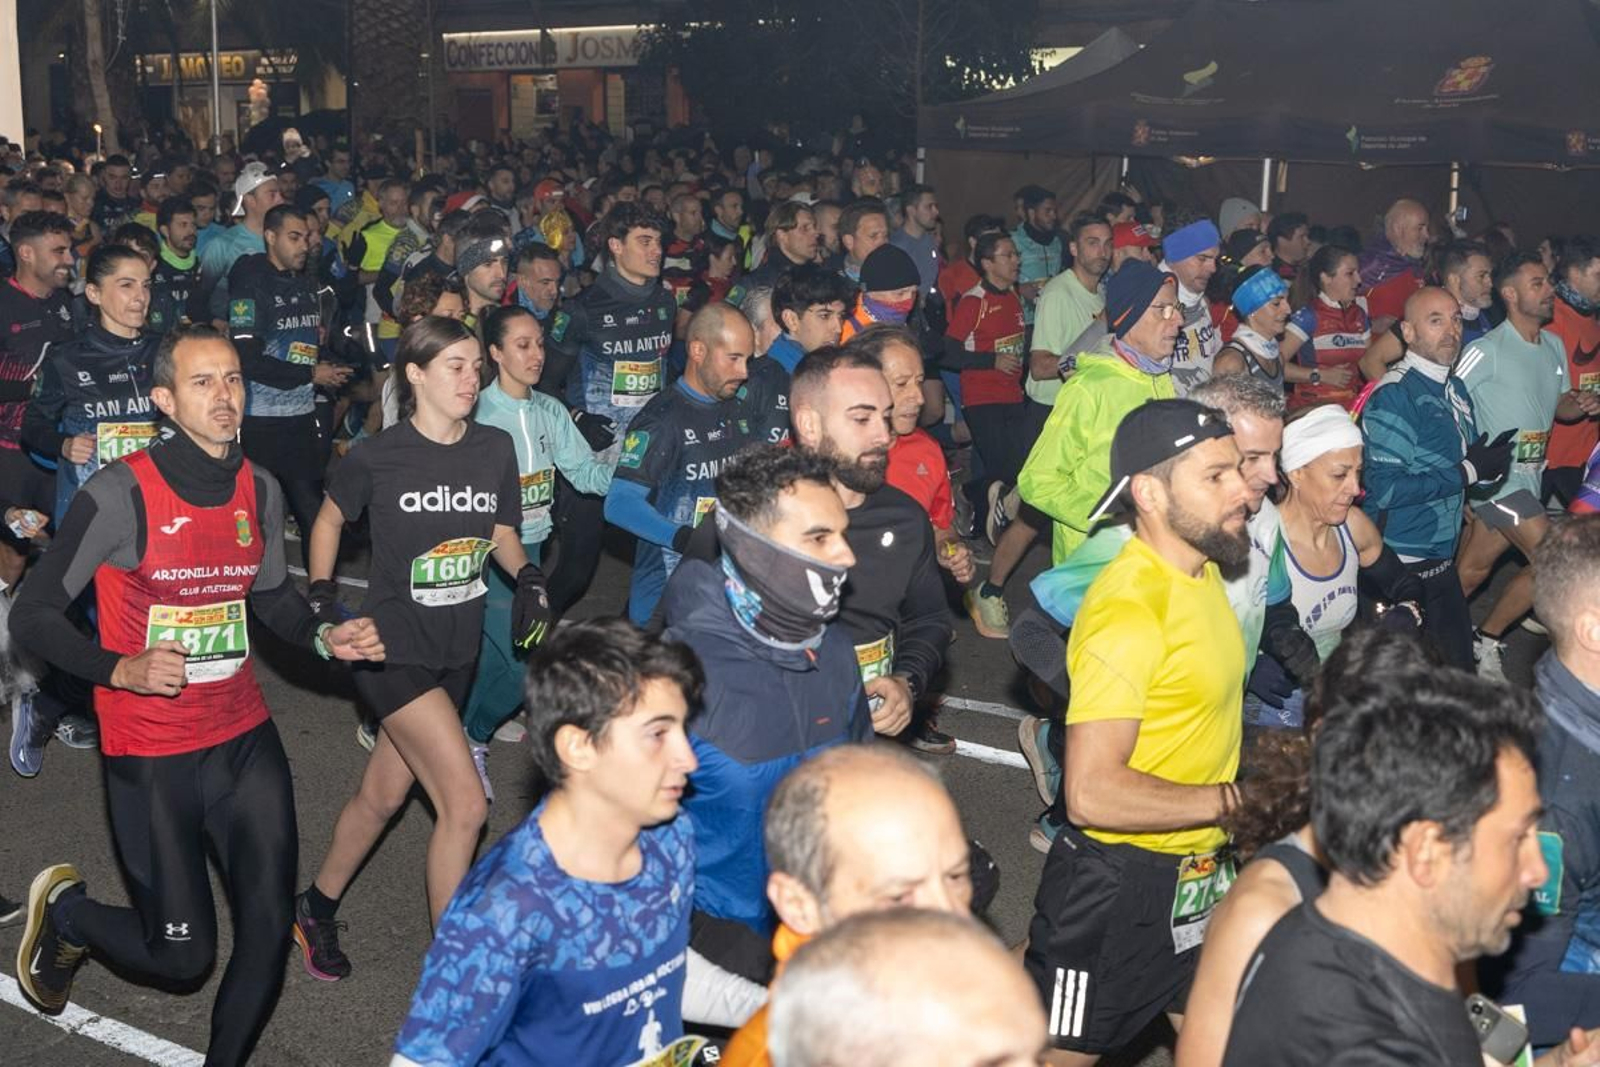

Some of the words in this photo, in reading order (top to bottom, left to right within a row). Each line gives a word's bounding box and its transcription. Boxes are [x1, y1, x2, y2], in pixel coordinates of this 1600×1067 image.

[447, 38, 557, 68] CONFECCION
[602, 340, 632, 355] SAN
[625, 373, 657, 391] 999
[84, 399, 120, 418] SAN
[126, 396, 158, 415] AN
[686, 459, 718, 481] SAN
[399, 484, 498, 514] adidas
[152, 566, 219, 581] ARJONILLA
[179, 586, 199, 596] CLUB
[202, 584, 243, 595] ATLETISMO
